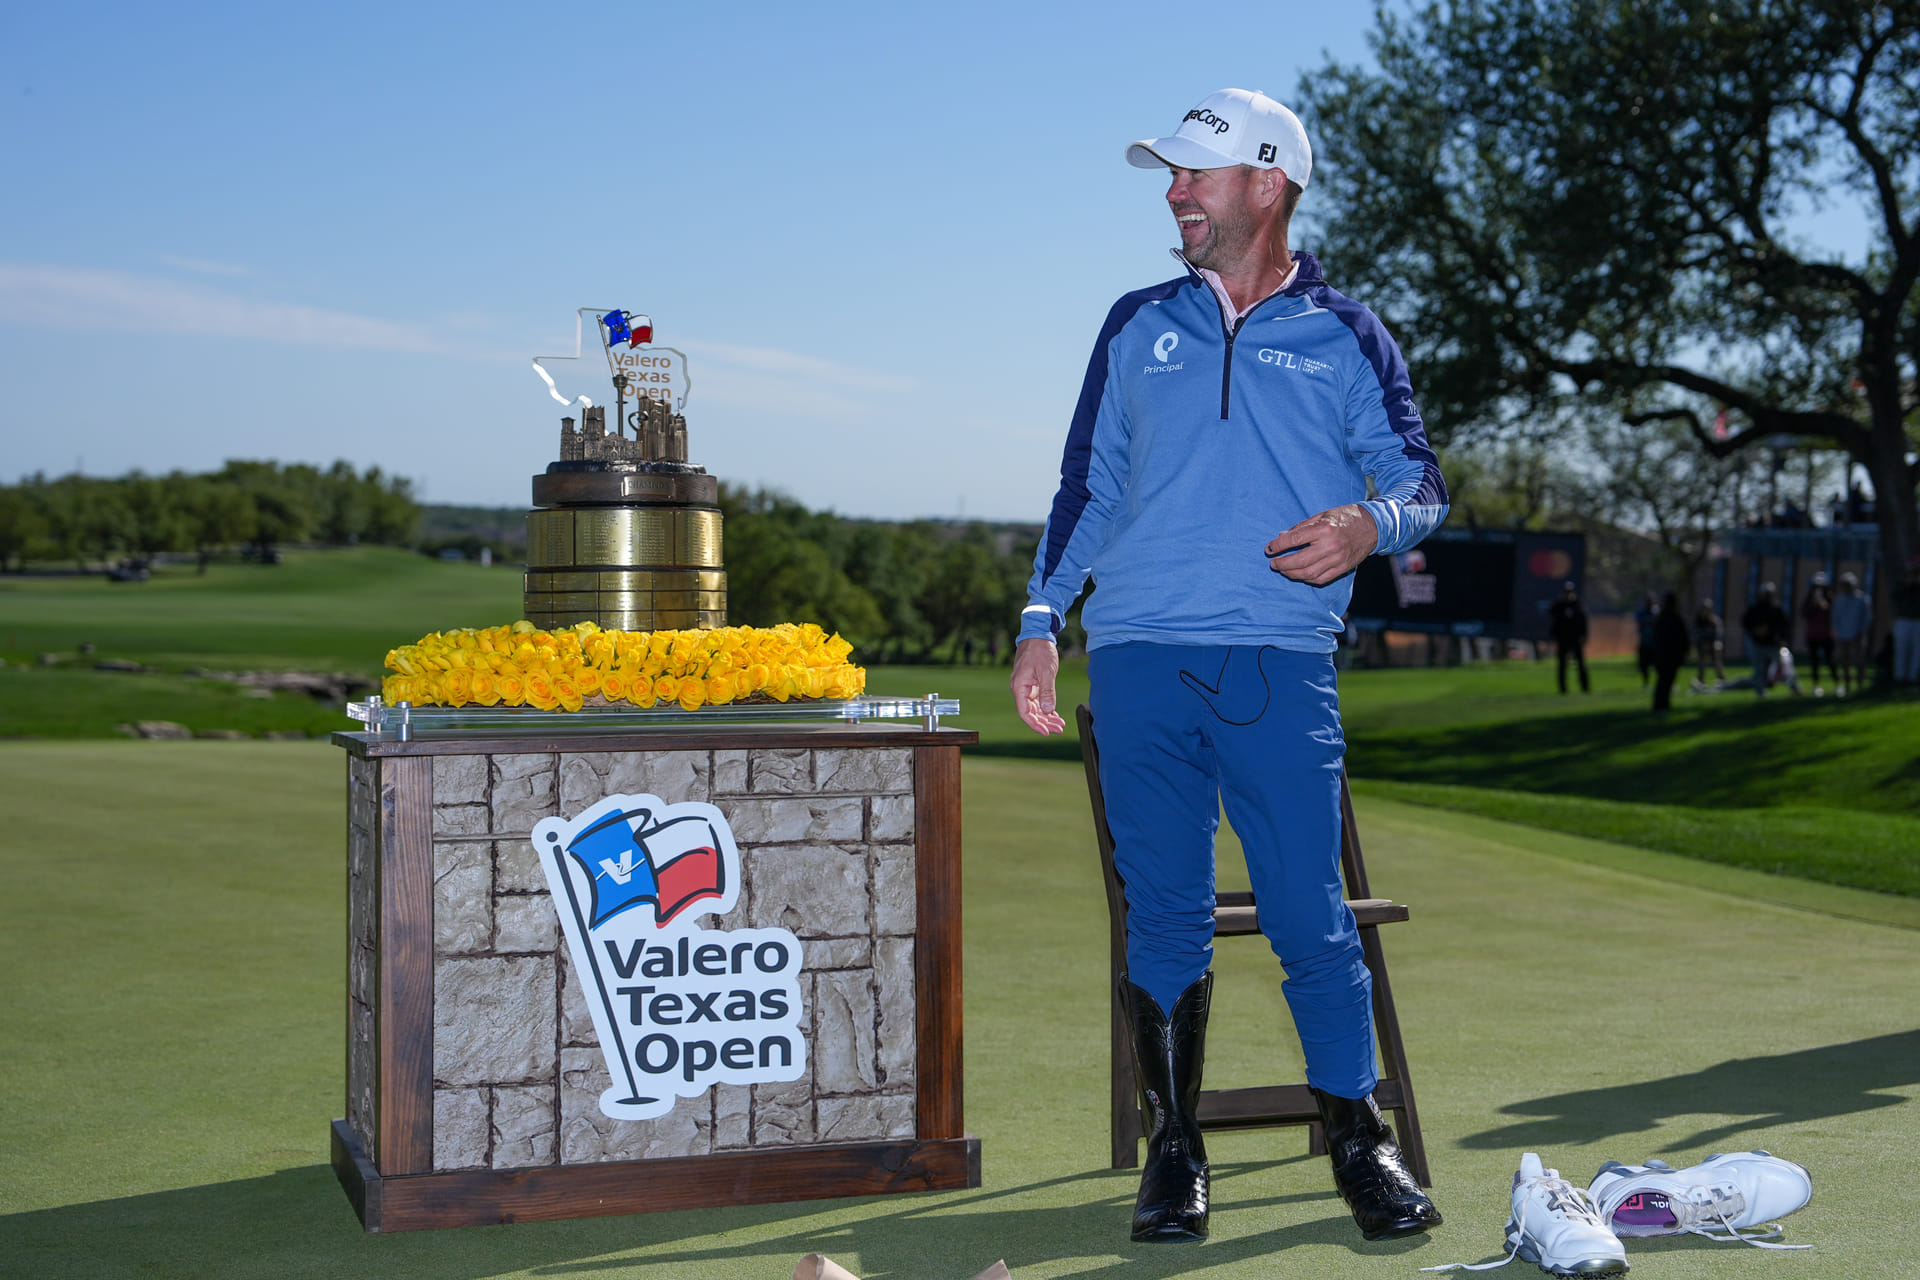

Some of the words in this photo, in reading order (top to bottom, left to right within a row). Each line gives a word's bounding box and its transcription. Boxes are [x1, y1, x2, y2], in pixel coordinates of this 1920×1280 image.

[1257, 142, 1278, 163] FJ
[612, 351, 672, 369] Valero
[1143, 361, 1185, 375] Principal
[1257, 347, 1297, 369] GTL
[616, 367, 671, 384] Texas
[622, 383, 672, 400] Open
[603, 936, 790, 979] Valero
[616, 985, 790, 1026] Texas
[634, 1032, 793, 1082] Open
